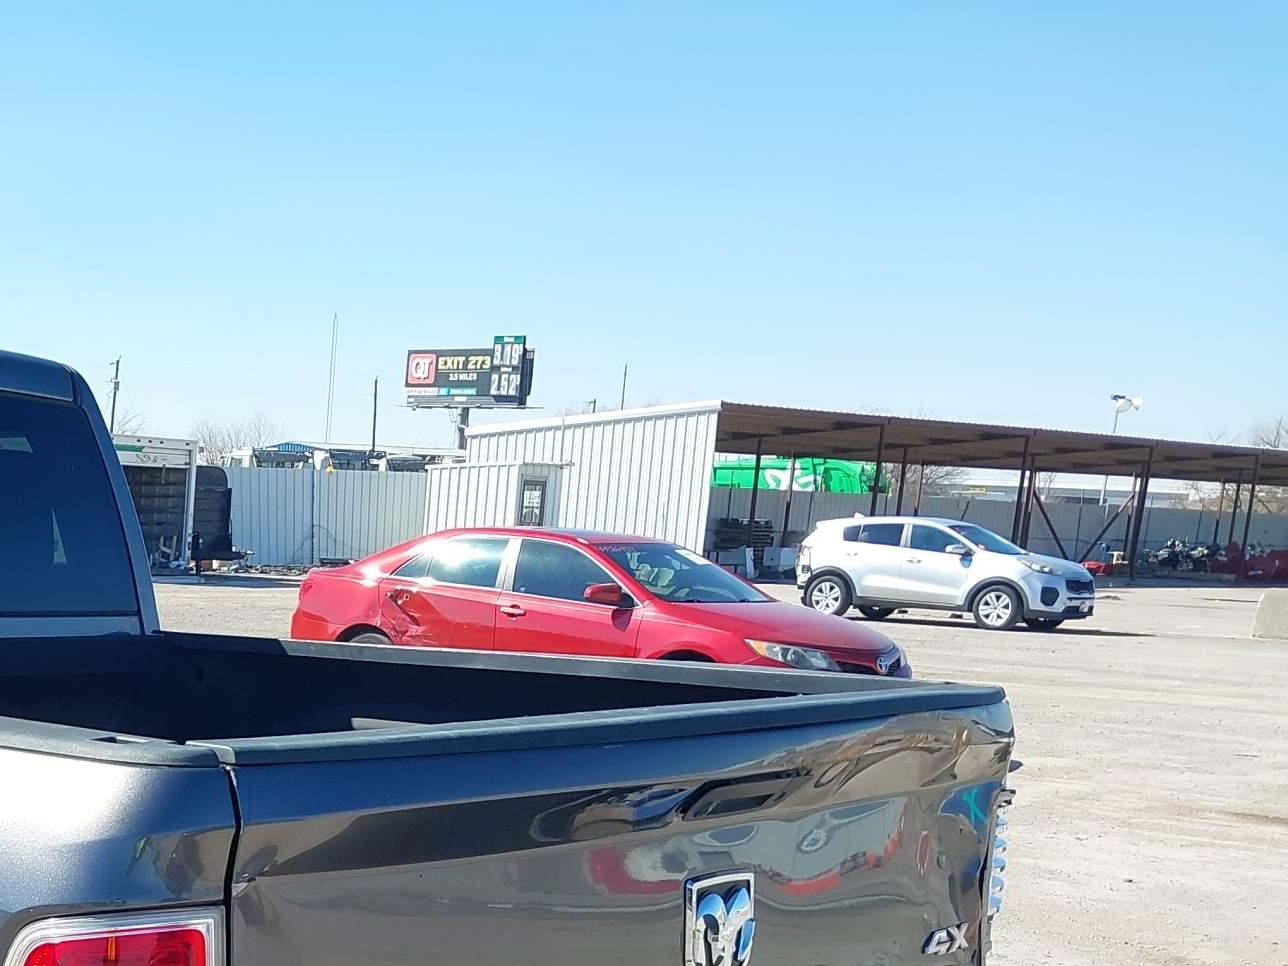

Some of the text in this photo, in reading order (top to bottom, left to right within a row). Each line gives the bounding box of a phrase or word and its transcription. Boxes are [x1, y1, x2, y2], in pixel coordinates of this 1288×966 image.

[412, 358, 433, 380] QT
[438, 356, 491, 370] EXIT 273
